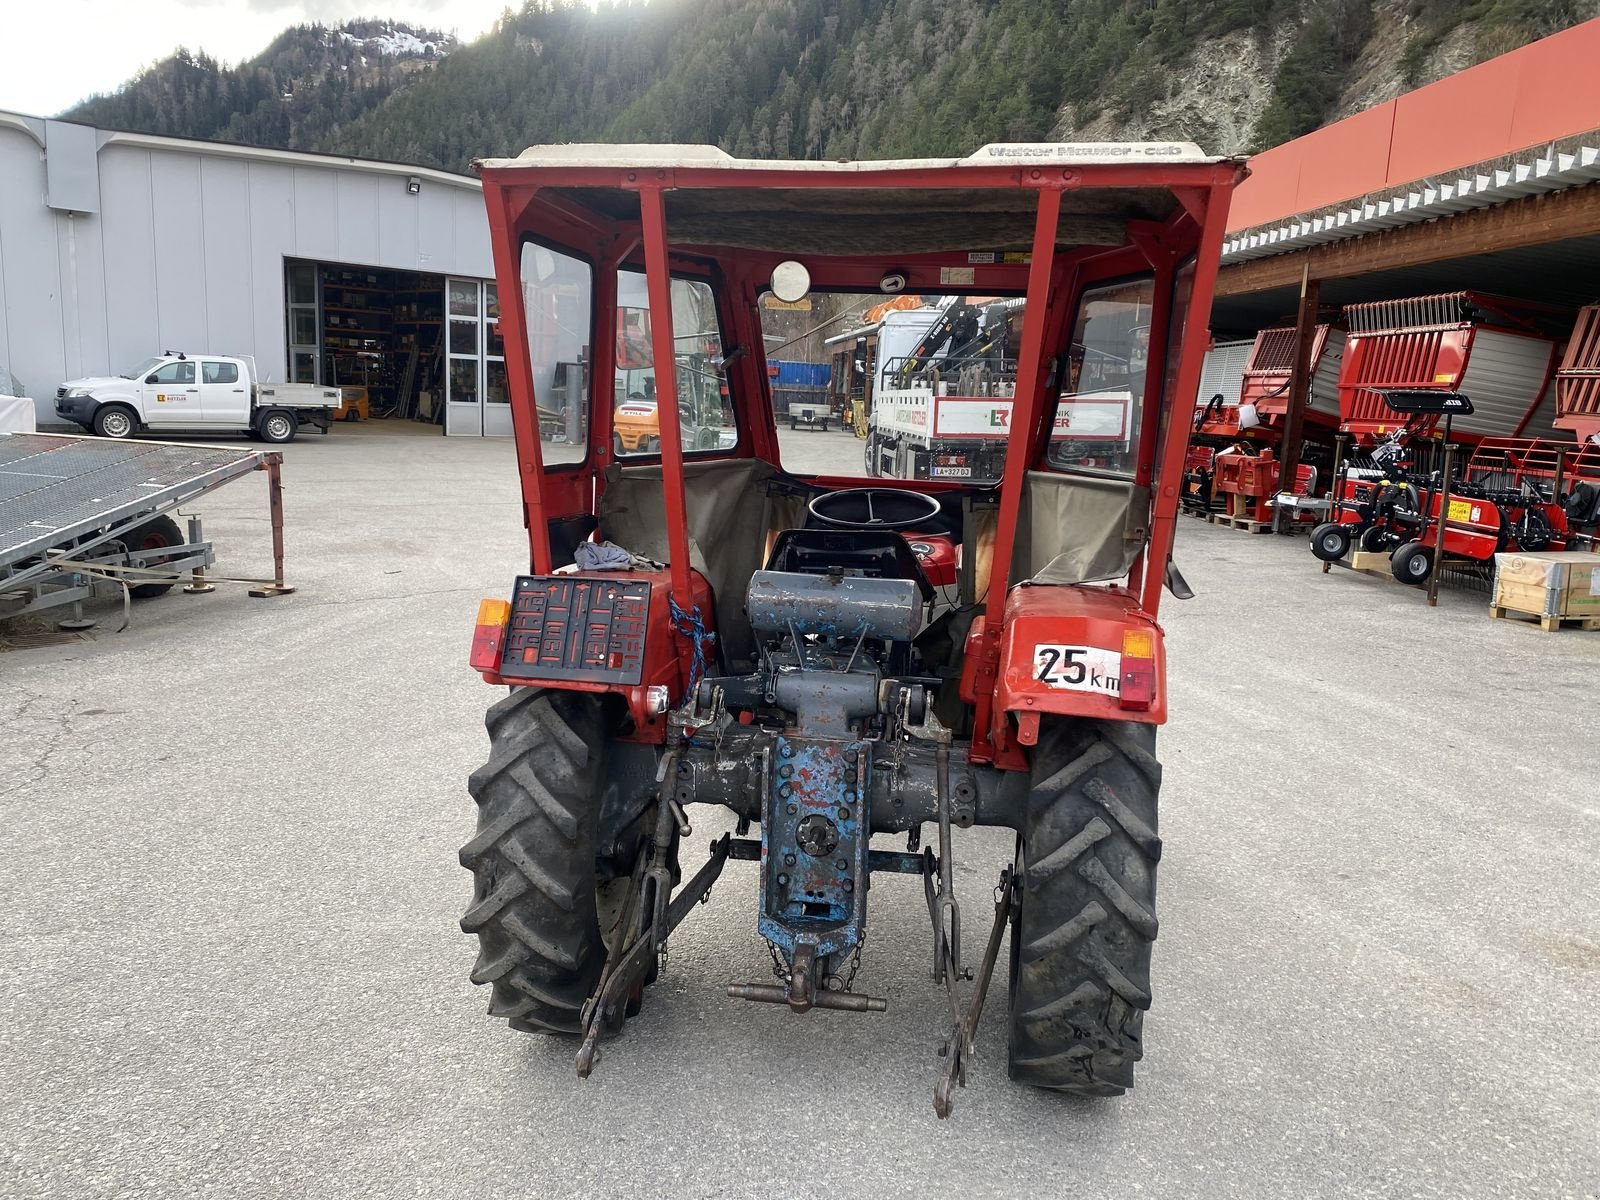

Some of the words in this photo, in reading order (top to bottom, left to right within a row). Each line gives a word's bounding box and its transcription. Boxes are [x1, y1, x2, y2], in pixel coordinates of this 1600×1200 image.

[988, 146, 1053, 157] Walter
[1144, 146, 1182, 156] cab
[1038, 648, 1087, 684] 25
[1091, 667, 1120, 692] km
